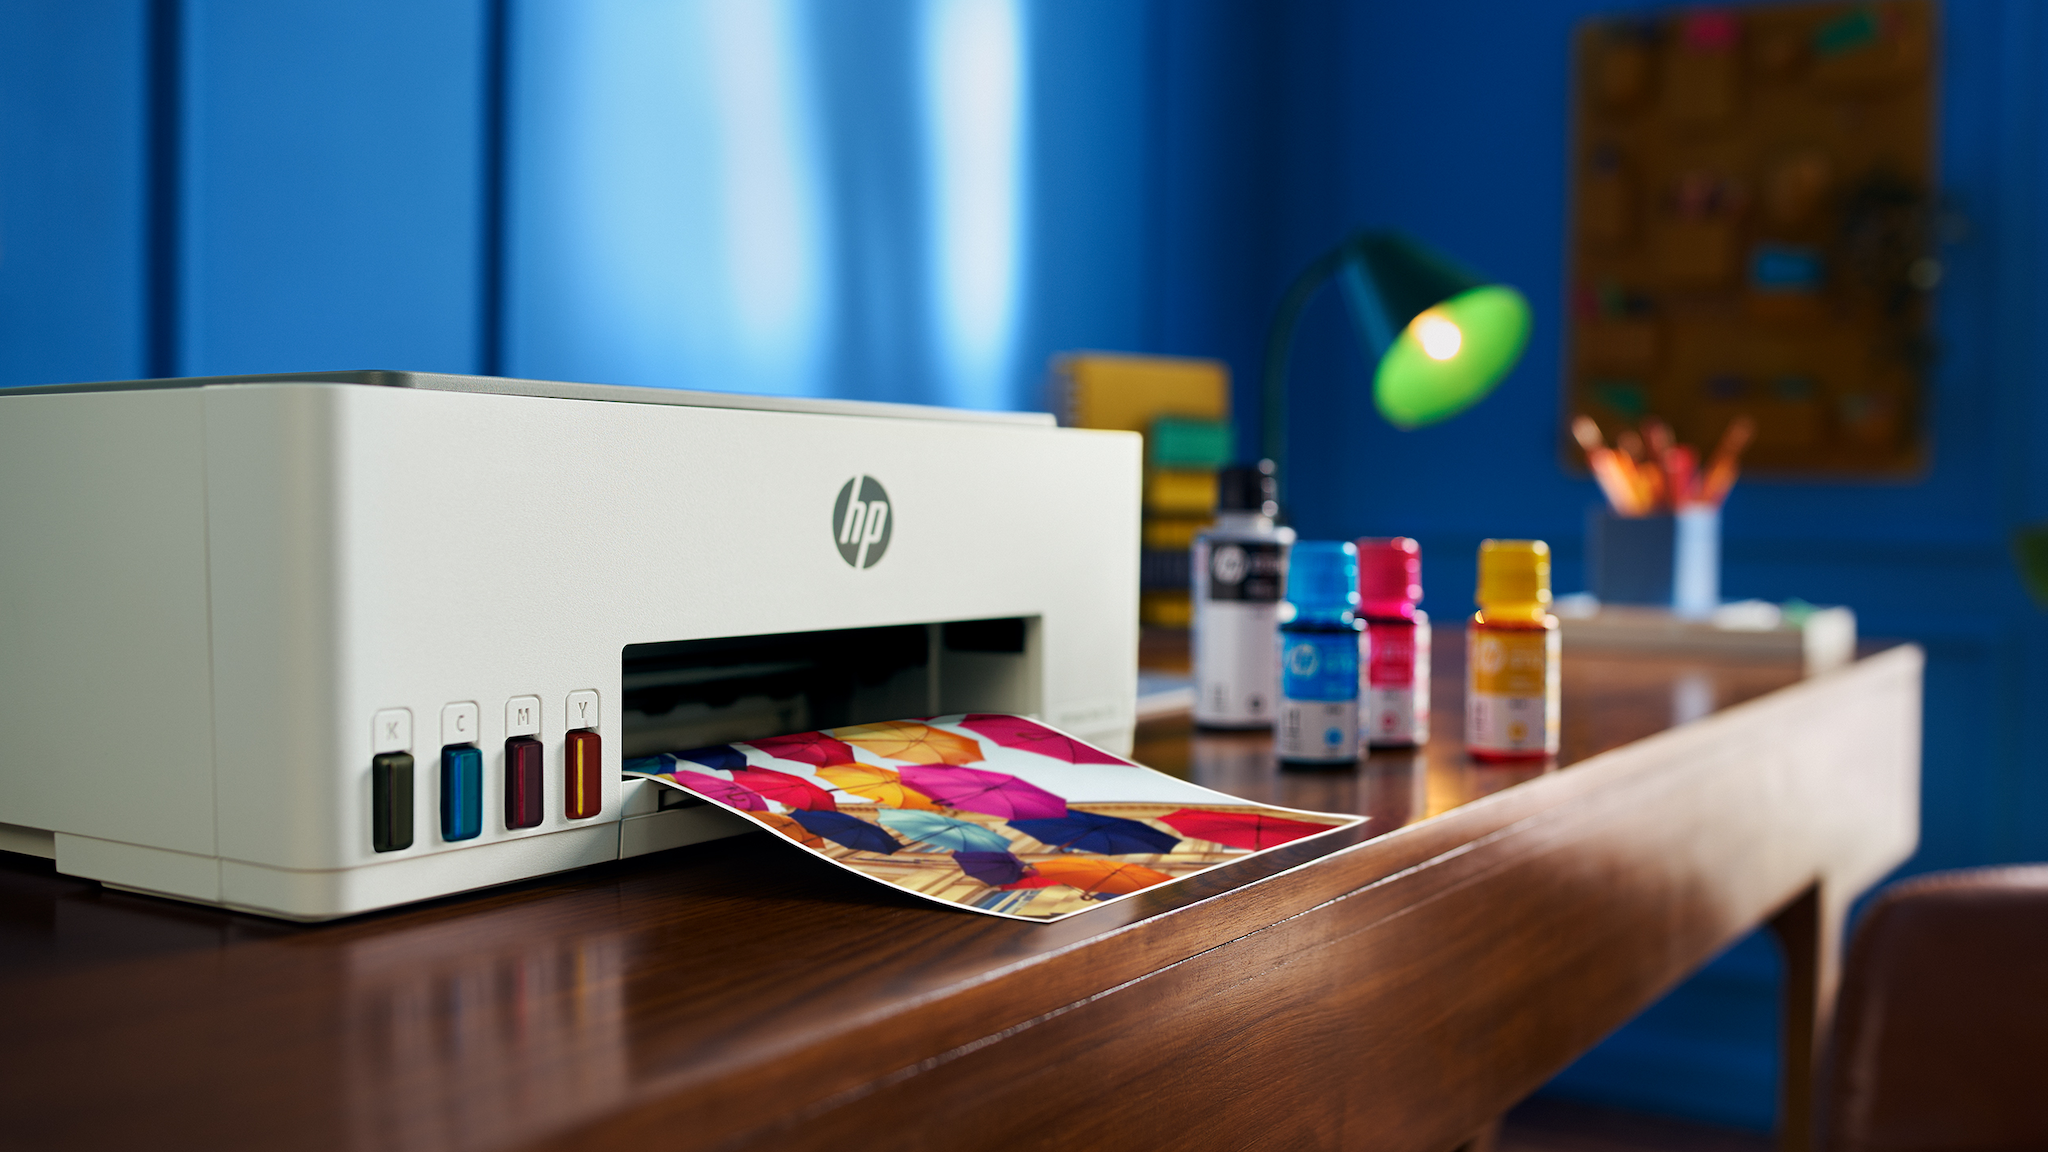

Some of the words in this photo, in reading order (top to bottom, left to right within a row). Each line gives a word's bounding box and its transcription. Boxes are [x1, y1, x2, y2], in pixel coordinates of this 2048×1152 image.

[837, 475, 890, 569] hp
[517, 707, 530, 726] M
[577, 701, 588, 719] Y
[386, 721, 398, 740] K
[456, 714, 465, 732] C
